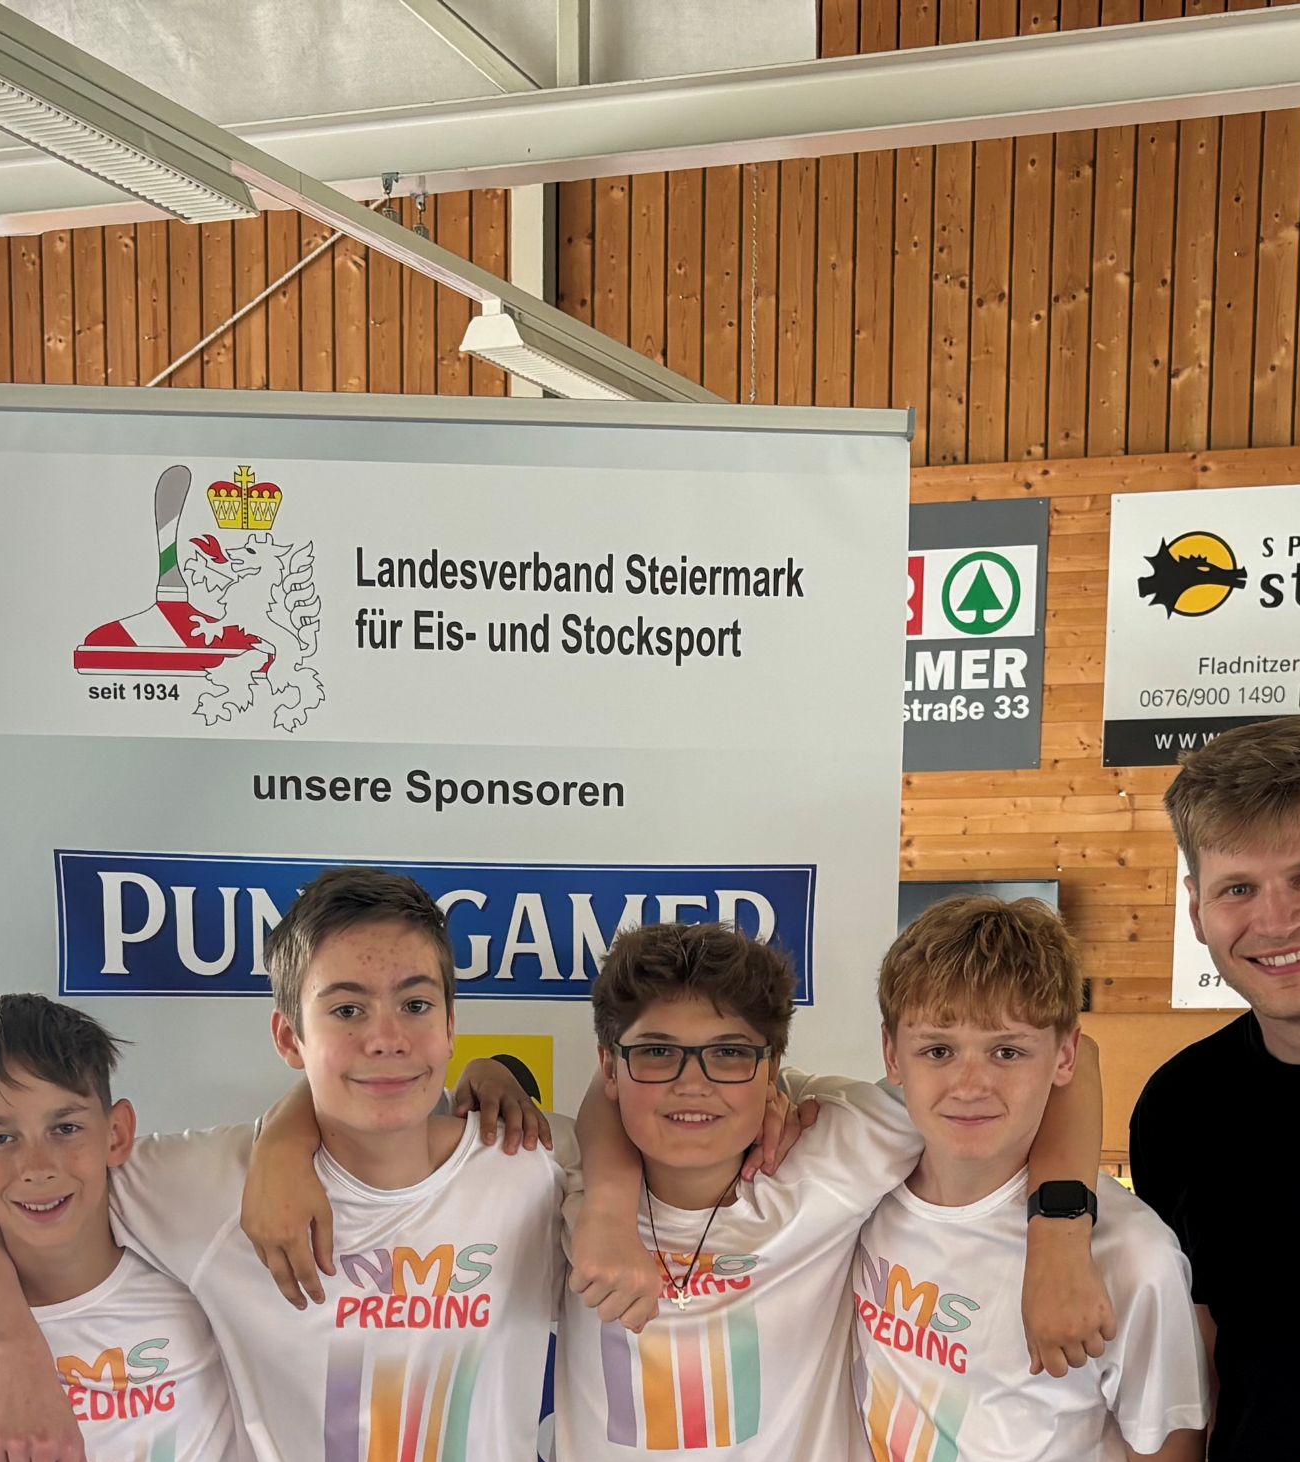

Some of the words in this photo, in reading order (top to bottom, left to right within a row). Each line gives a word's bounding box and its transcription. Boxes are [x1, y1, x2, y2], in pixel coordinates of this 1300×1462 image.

[356, 546, 614, 593] Landesverband
[626, 553, 804, 597] Steiermark
[356, 608, 403, 649] für
[413, 610, 476, 651] Eis-
[488, 613, 549, 653] und
[561, 614, 741, 666] Stocksport
[904, 648, 1028, 691] MER
[1198, 656, 1300, 676] Fladnitzer
[88, 682, 126, 701] seit
[132, 684, 180, 702] 1934
[993, 695, 1031, 720] 33
[1139, 687, 1230, 708] 0676/900
[1238, 686, 1286, 705] 1490
[252, 773, 393, 804] unsere
[405, 771, 625, 813] Sponsoren
[340, 1243, 498, 1296] NMS
[860, 1243, 980, 1332] NMS
[335, 1294, 490, 1329] PREDING
[57, 1338, 169, 1391] MS
[68, 1380, 176, 1421] EDING
